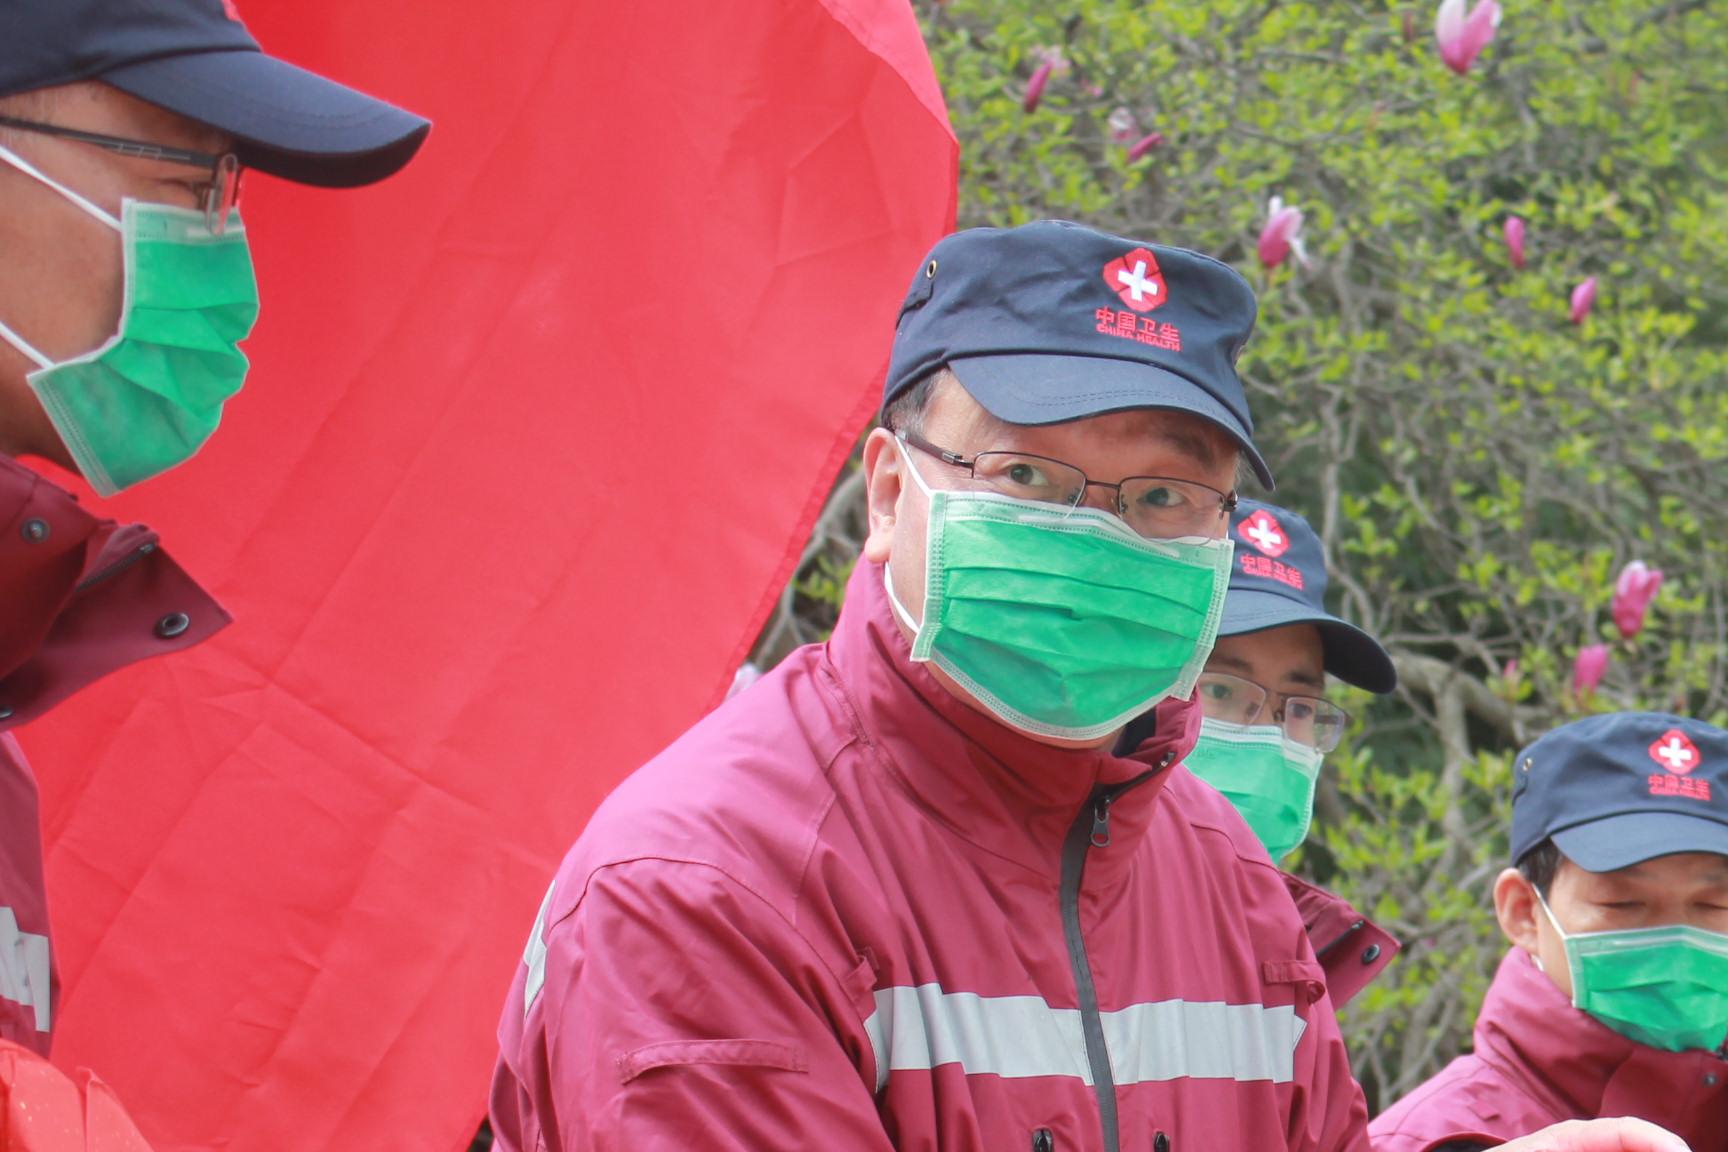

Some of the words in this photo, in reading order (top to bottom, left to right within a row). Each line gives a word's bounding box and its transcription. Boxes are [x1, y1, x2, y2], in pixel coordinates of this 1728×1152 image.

[1095, 306, 1181, 343] 中国卫生
[1137, 333, 1182, 352] HEALTH
